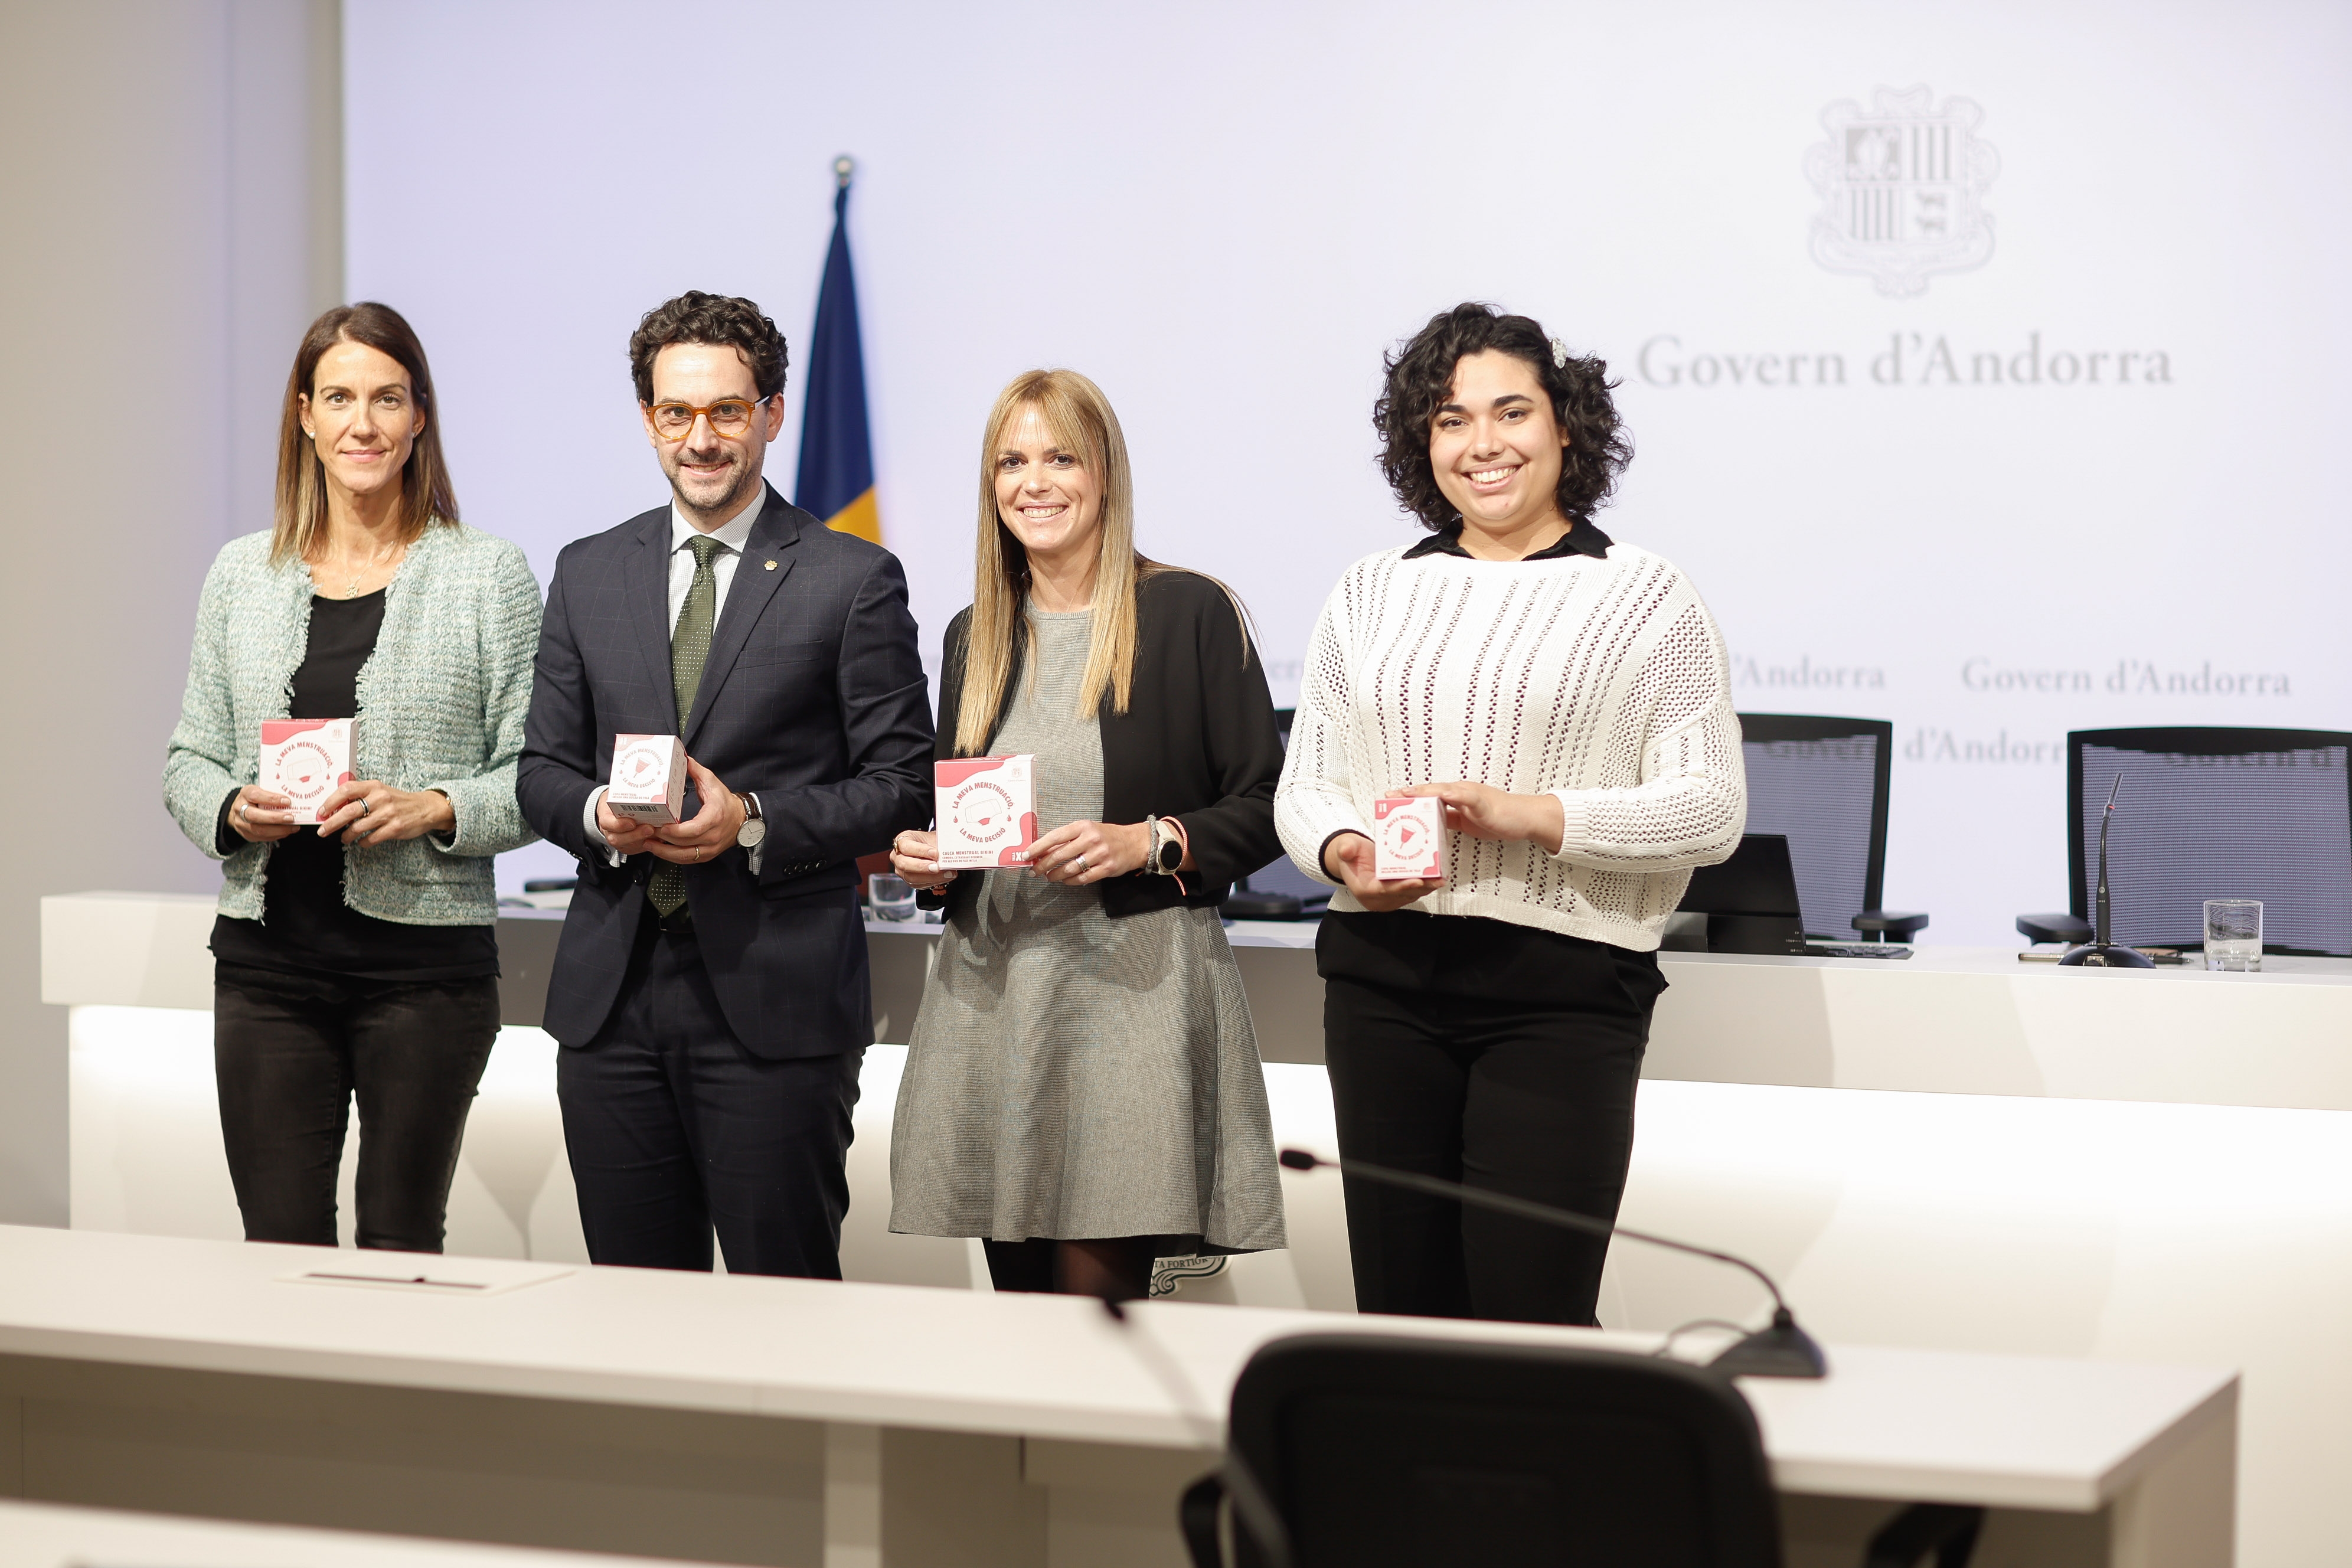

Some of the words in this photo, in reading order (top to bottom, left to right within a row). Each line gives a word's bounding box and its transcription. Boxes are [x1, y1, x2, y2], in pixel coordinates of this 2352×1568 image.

[1635, 334, 1848, 388] Govern
[1869, 329, 2174, 387] d'Andorra
[1734, 653, 1886, 690] 'Andorra
[1960, 657, 2093, 692] Govern
[2105, 659, 2291, 697] d'Andorra
[280, 744, 296, 757] MEVA
[625, 750, 636, 760] MEVA
[1903, 727, 2067, 764] d'Andorr
[281, 784, 288, 792] LA
[288, 790, 303, 799] MEVA
[952, 801, 959, 809] LA
[956, 785, 974, 801] MEVA
[974, 782, 1015, 809] MENSTRUACIÓ,
[959, 828, 967, 836] LA
[966, 834, 983, 843] MEVA
[984, 827, 1006, 842] DECISIÓ
